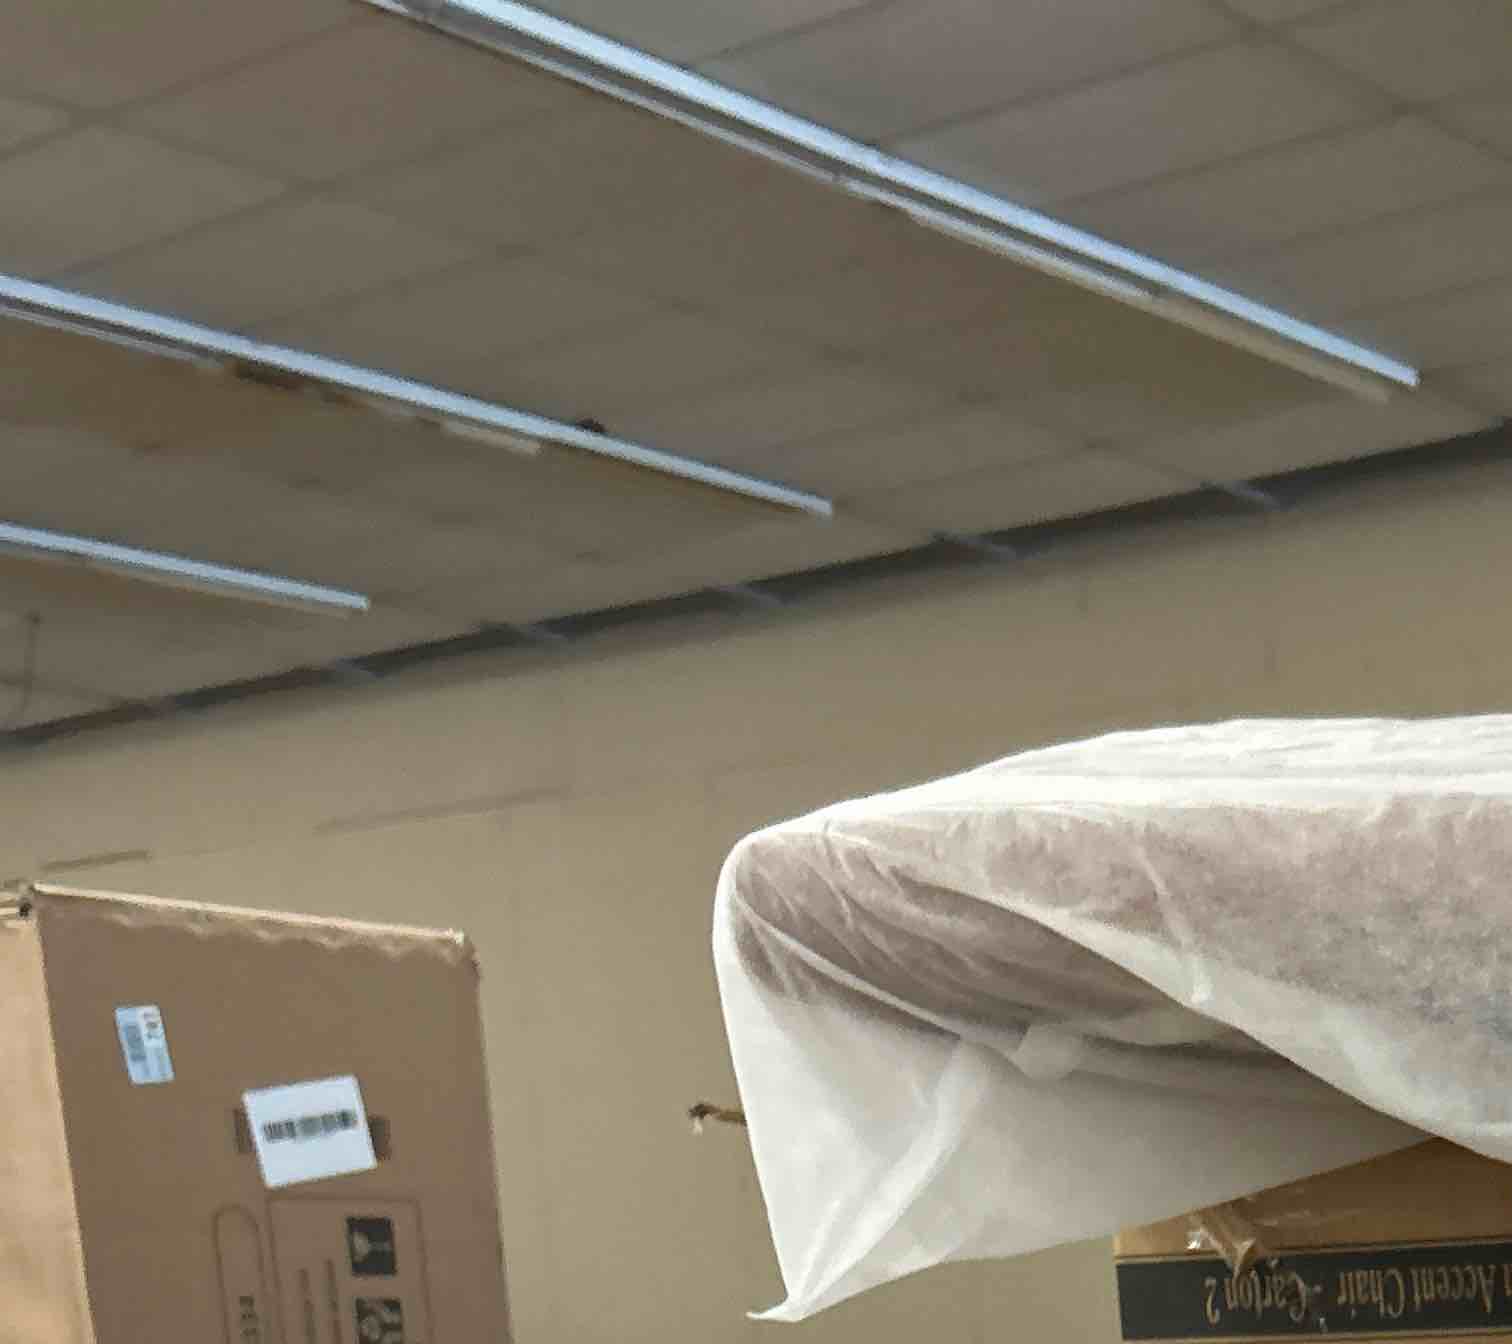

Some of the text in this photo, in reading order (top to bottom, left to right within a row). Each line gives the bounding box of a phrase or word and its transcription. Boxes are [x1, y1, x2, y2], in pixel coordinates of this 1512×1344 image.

[1204, 1276, 1221, 1326] 2
[1338, 1267, 1406, 1319] Chair
[1407, 1262, 1495, 1313] Accent
